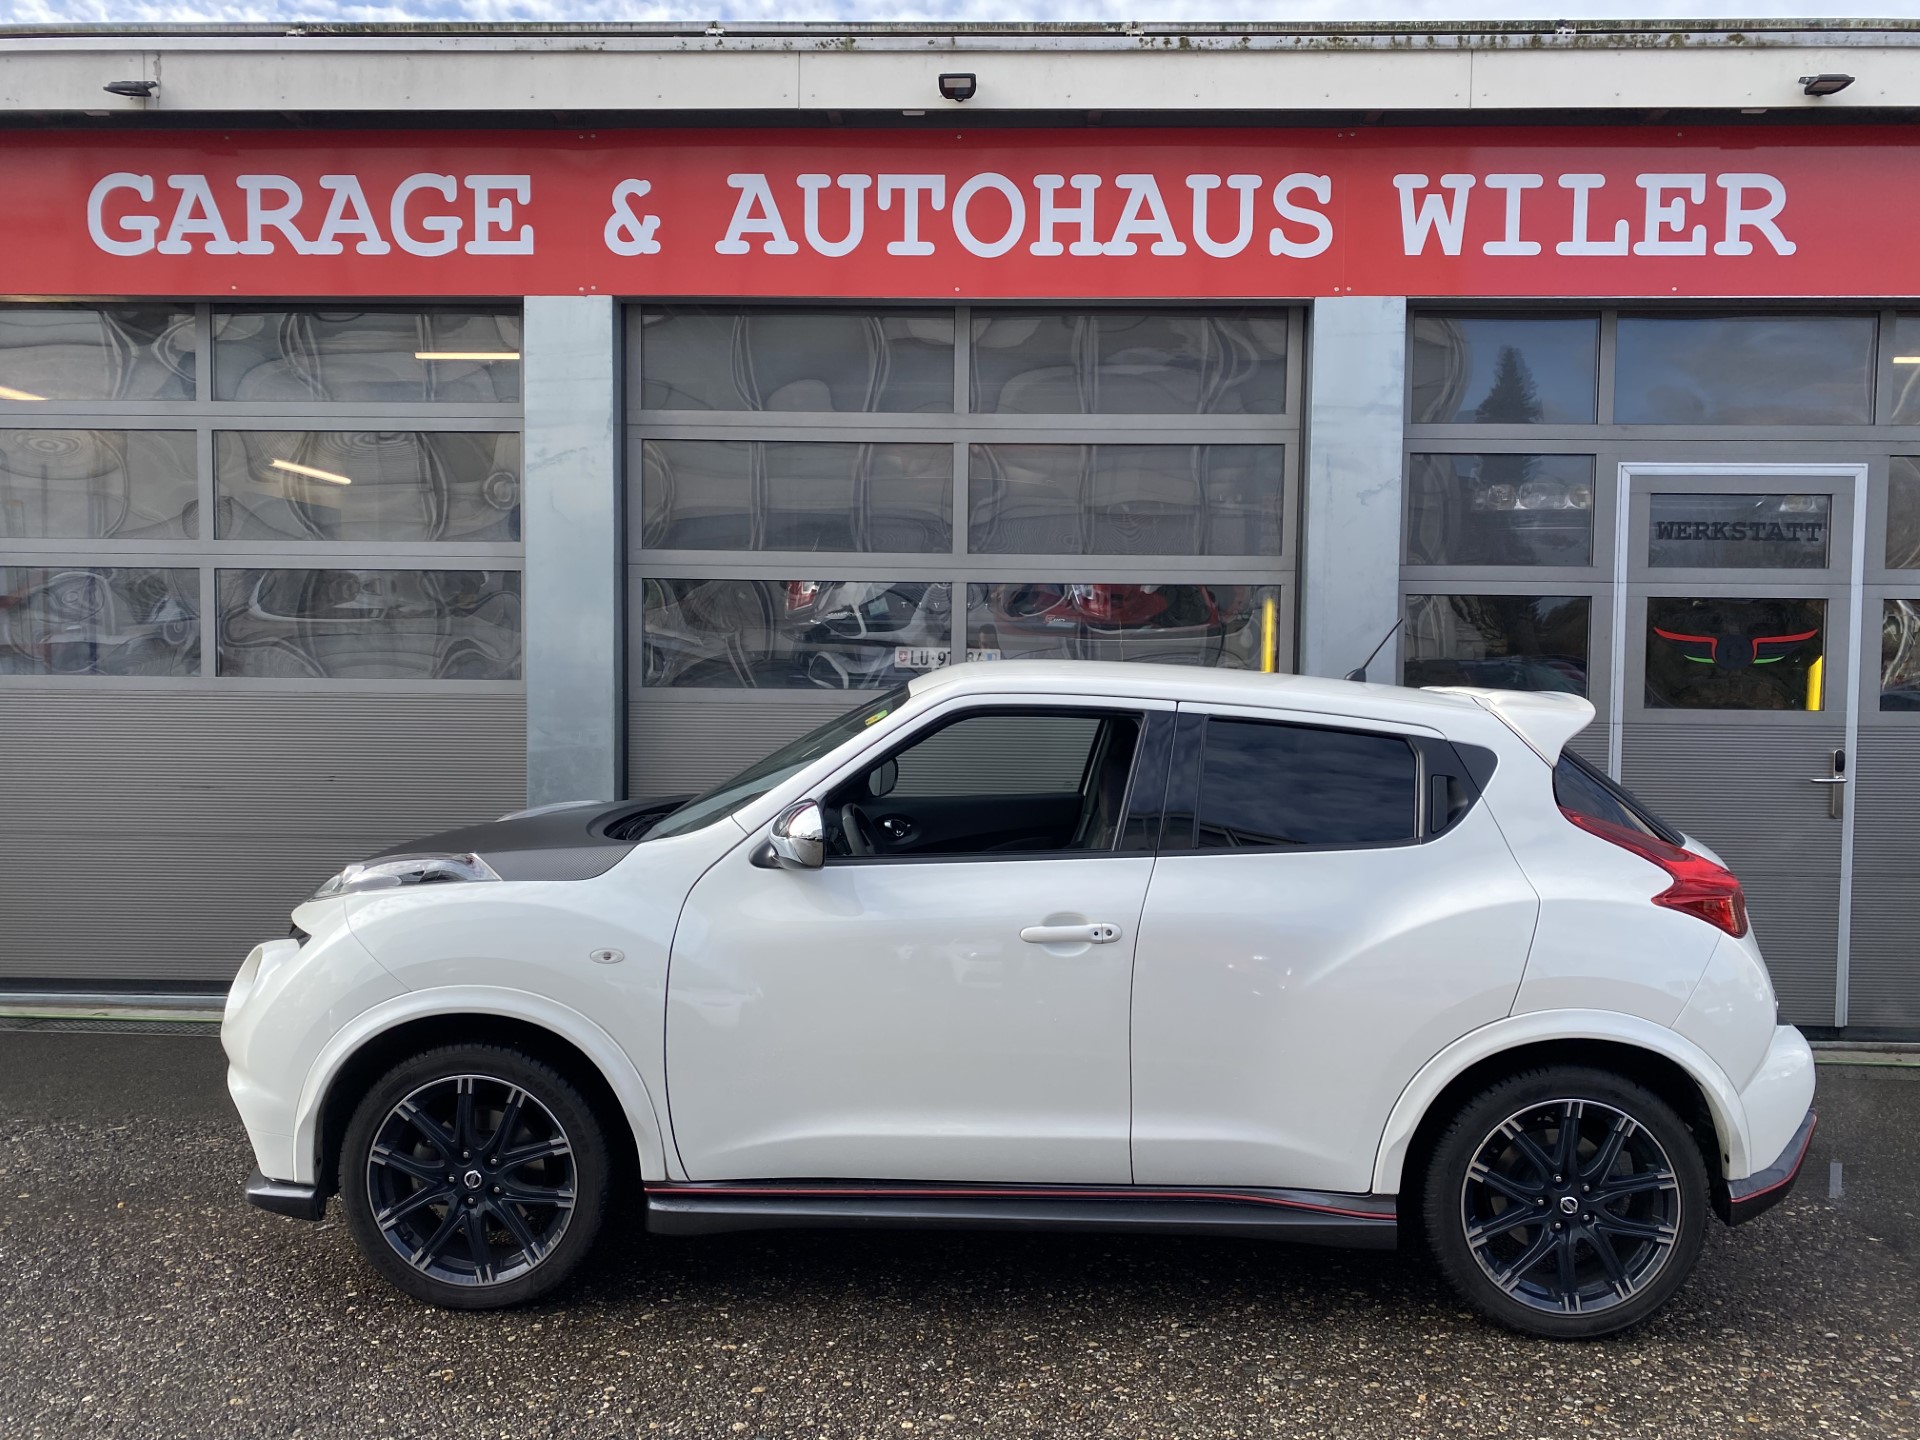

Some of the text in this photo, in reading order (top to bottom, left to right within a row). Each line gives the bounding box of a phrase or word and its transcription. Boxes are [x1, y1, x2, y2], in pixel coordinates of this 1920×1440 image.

[87, 172, 1797, 258] GARAGE & AUTOHAUS WILER
[1656, 521, 1822, 542] WERKSTATT
